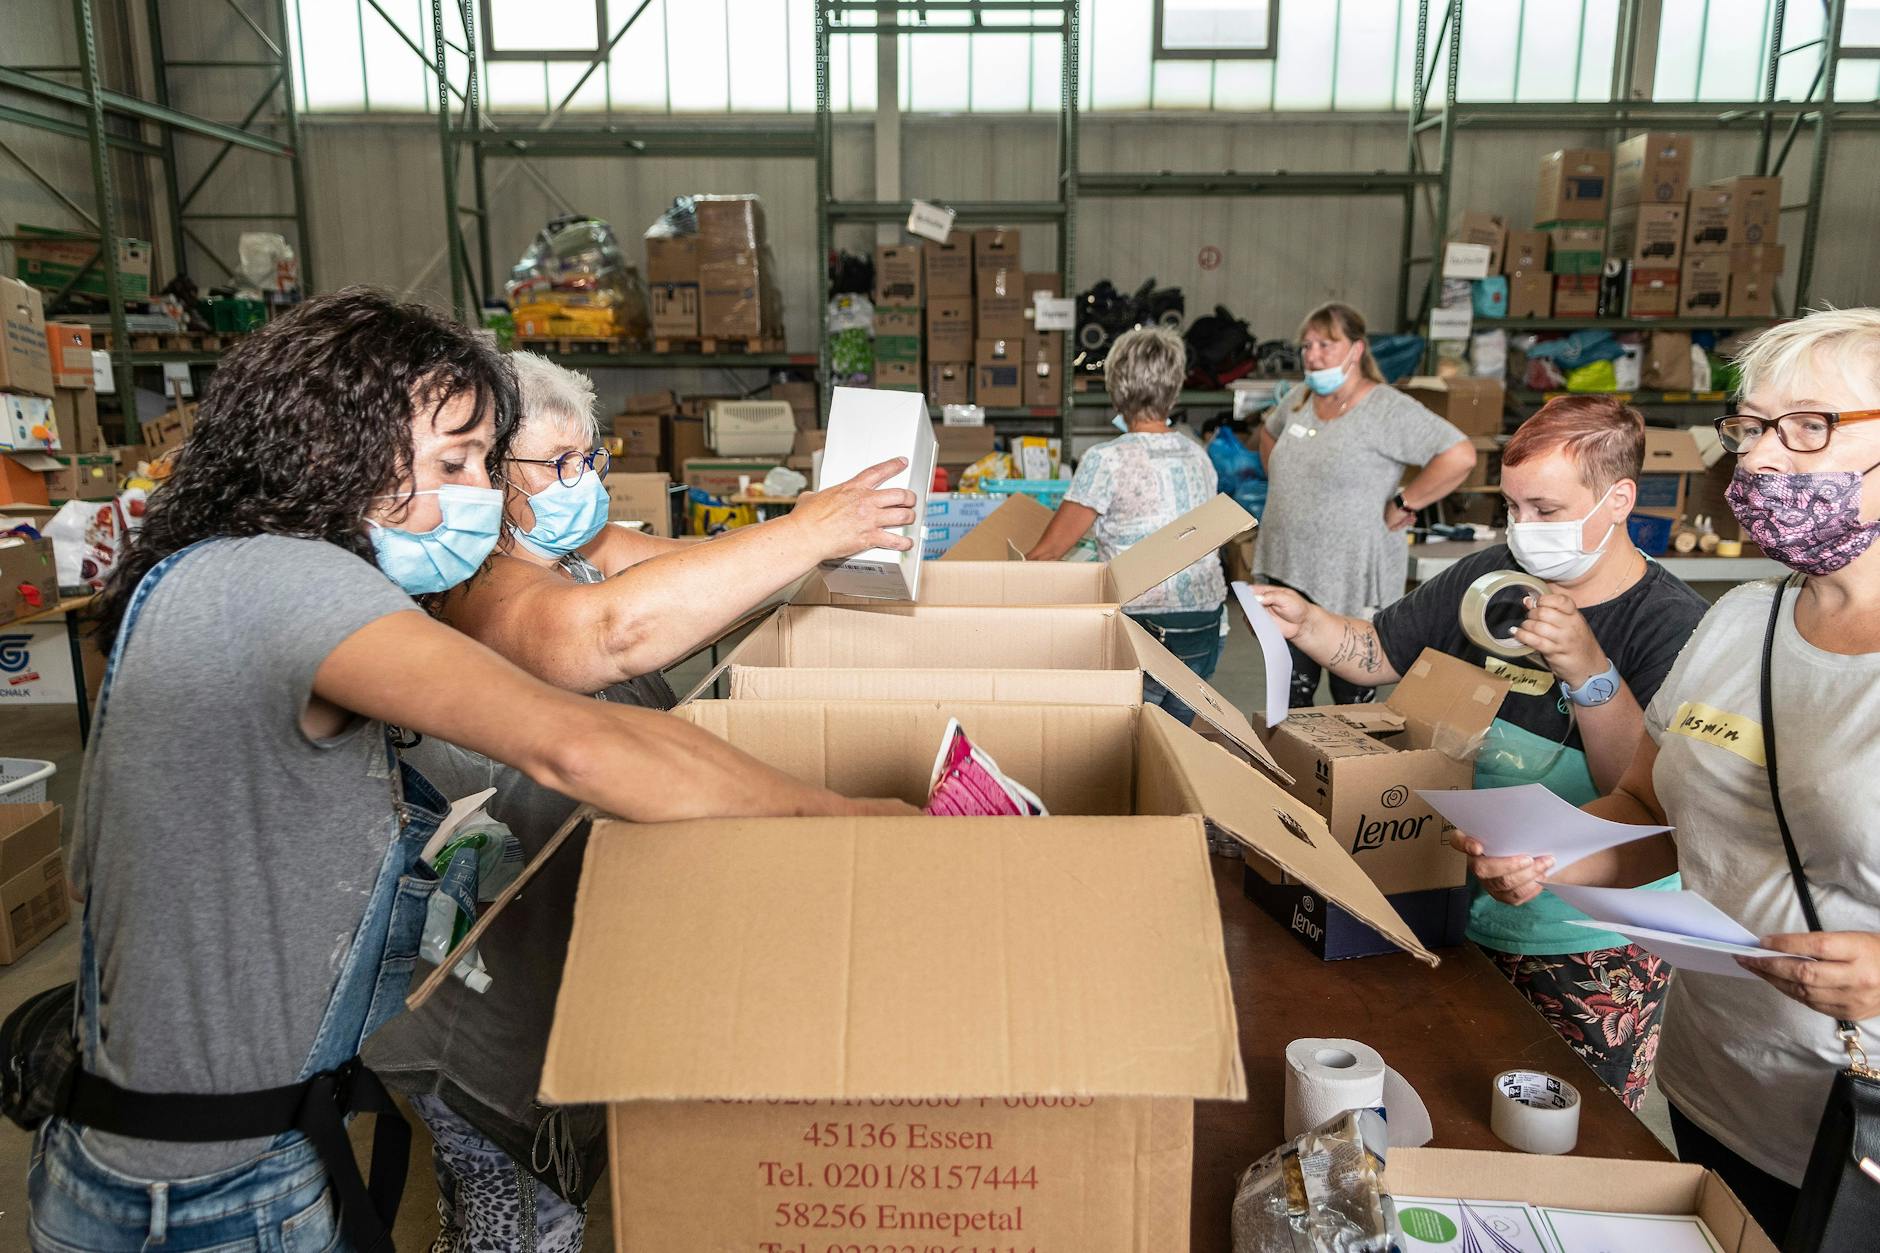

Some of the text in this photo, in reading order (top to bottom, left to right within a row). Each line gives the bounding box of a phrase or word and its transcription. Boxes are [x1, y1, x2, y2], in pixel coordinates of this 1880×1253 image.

[1351, 814, 1433, 855] Lenor
[1291, 903, 1324, 942] Lenor
[802, 1121, 994, 1150] 45136 Essen
[758, 1161, 1040, 1191] Tel. 0201/8157444
[774, 1202, 1024, 1238] 58256 Ennepetal
